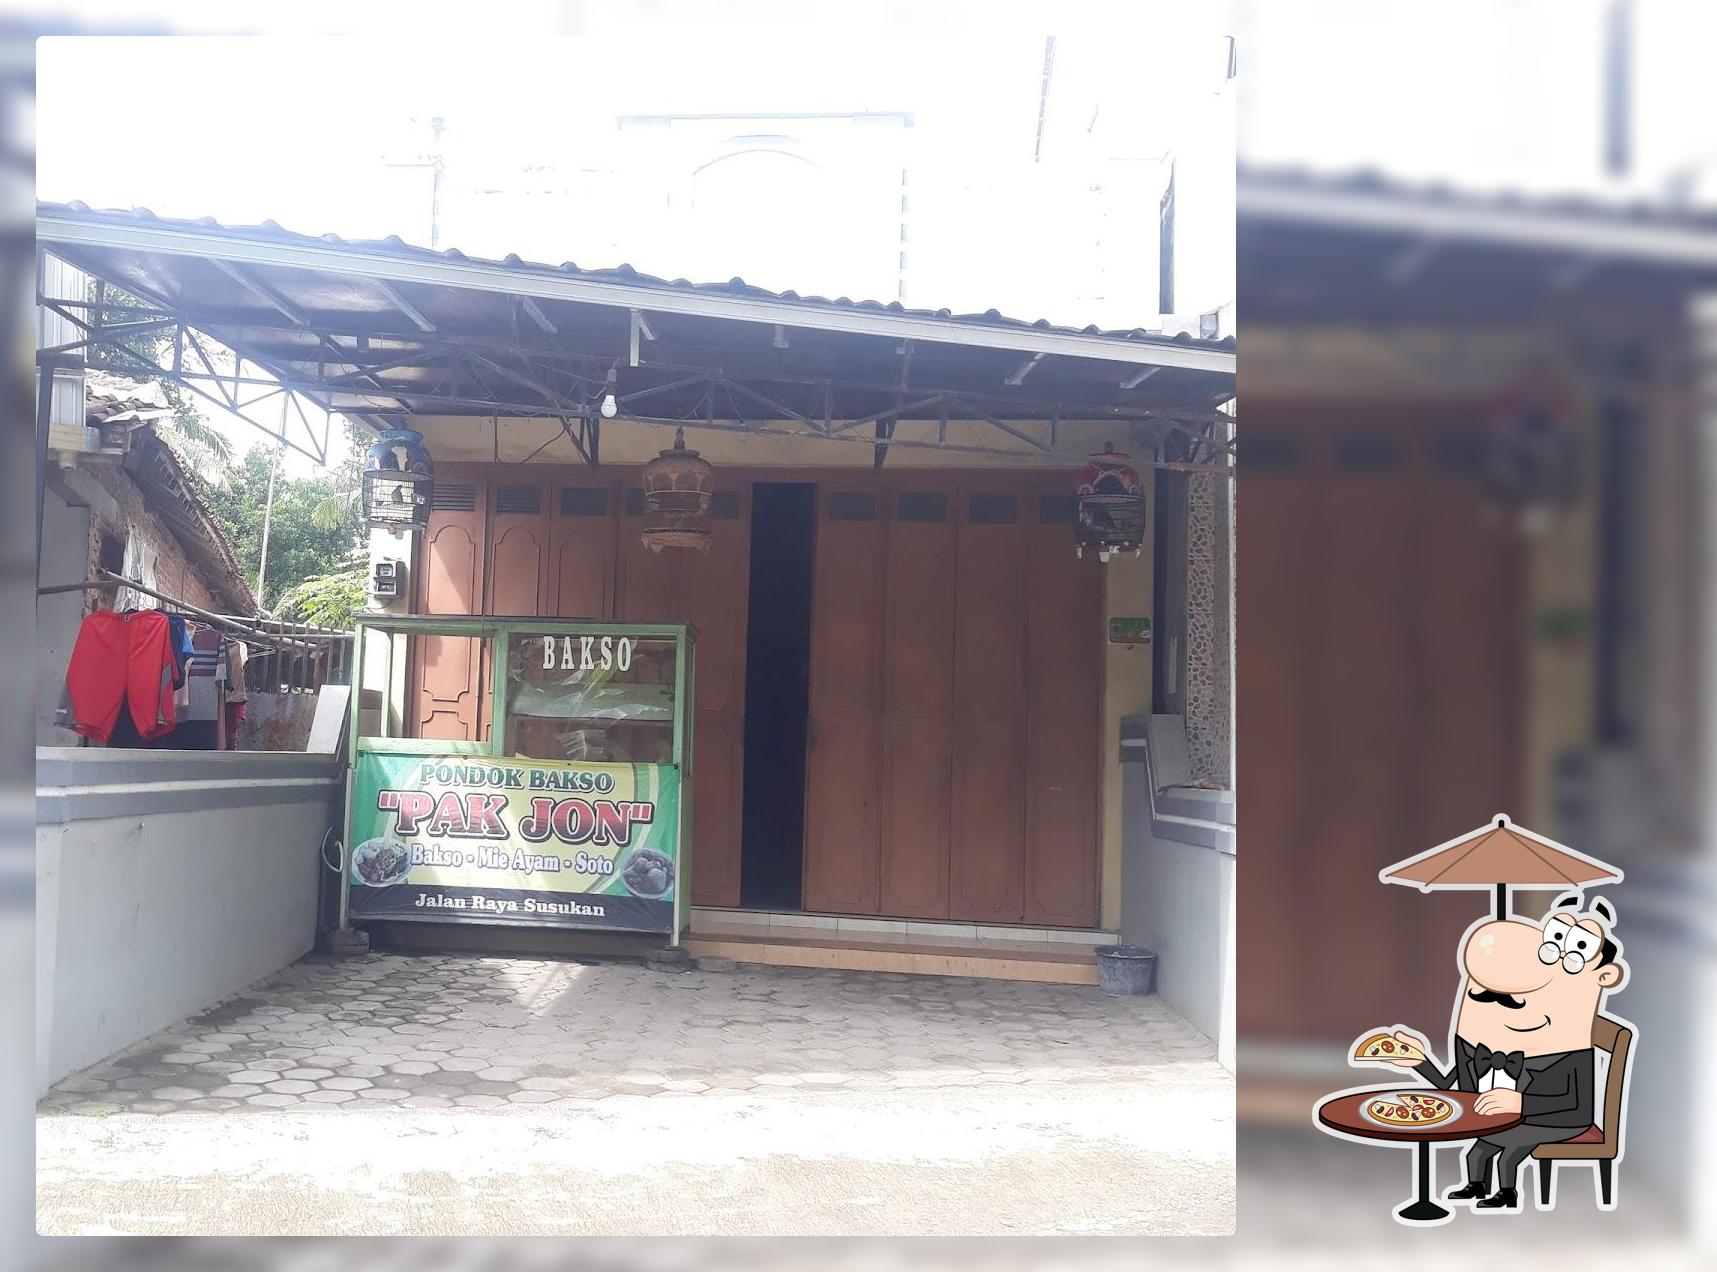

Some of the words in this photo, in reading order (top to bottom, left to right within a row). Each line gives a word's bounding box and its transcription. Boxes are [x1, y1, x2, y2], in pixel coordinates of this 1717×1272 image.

[543, 636, 632, 671] BAKSO
[420, 765, 524, 790] PONDOK
[528, 771, 615, 793] BAKSO
[377, 790, 511, 840] "PAK
[519, 797, 654, 846] JON"
[411, 844, 463, 867] Bakso
[477, 847, 510, 869] Mie
[511, 849, 561, 874] Ayam
[576, 853, 615, 875] Soto
[415, 893, 467, 909] Jalan
[471, 895, 518, 913] Raya
[524, 898, 606, 916] Susukan
